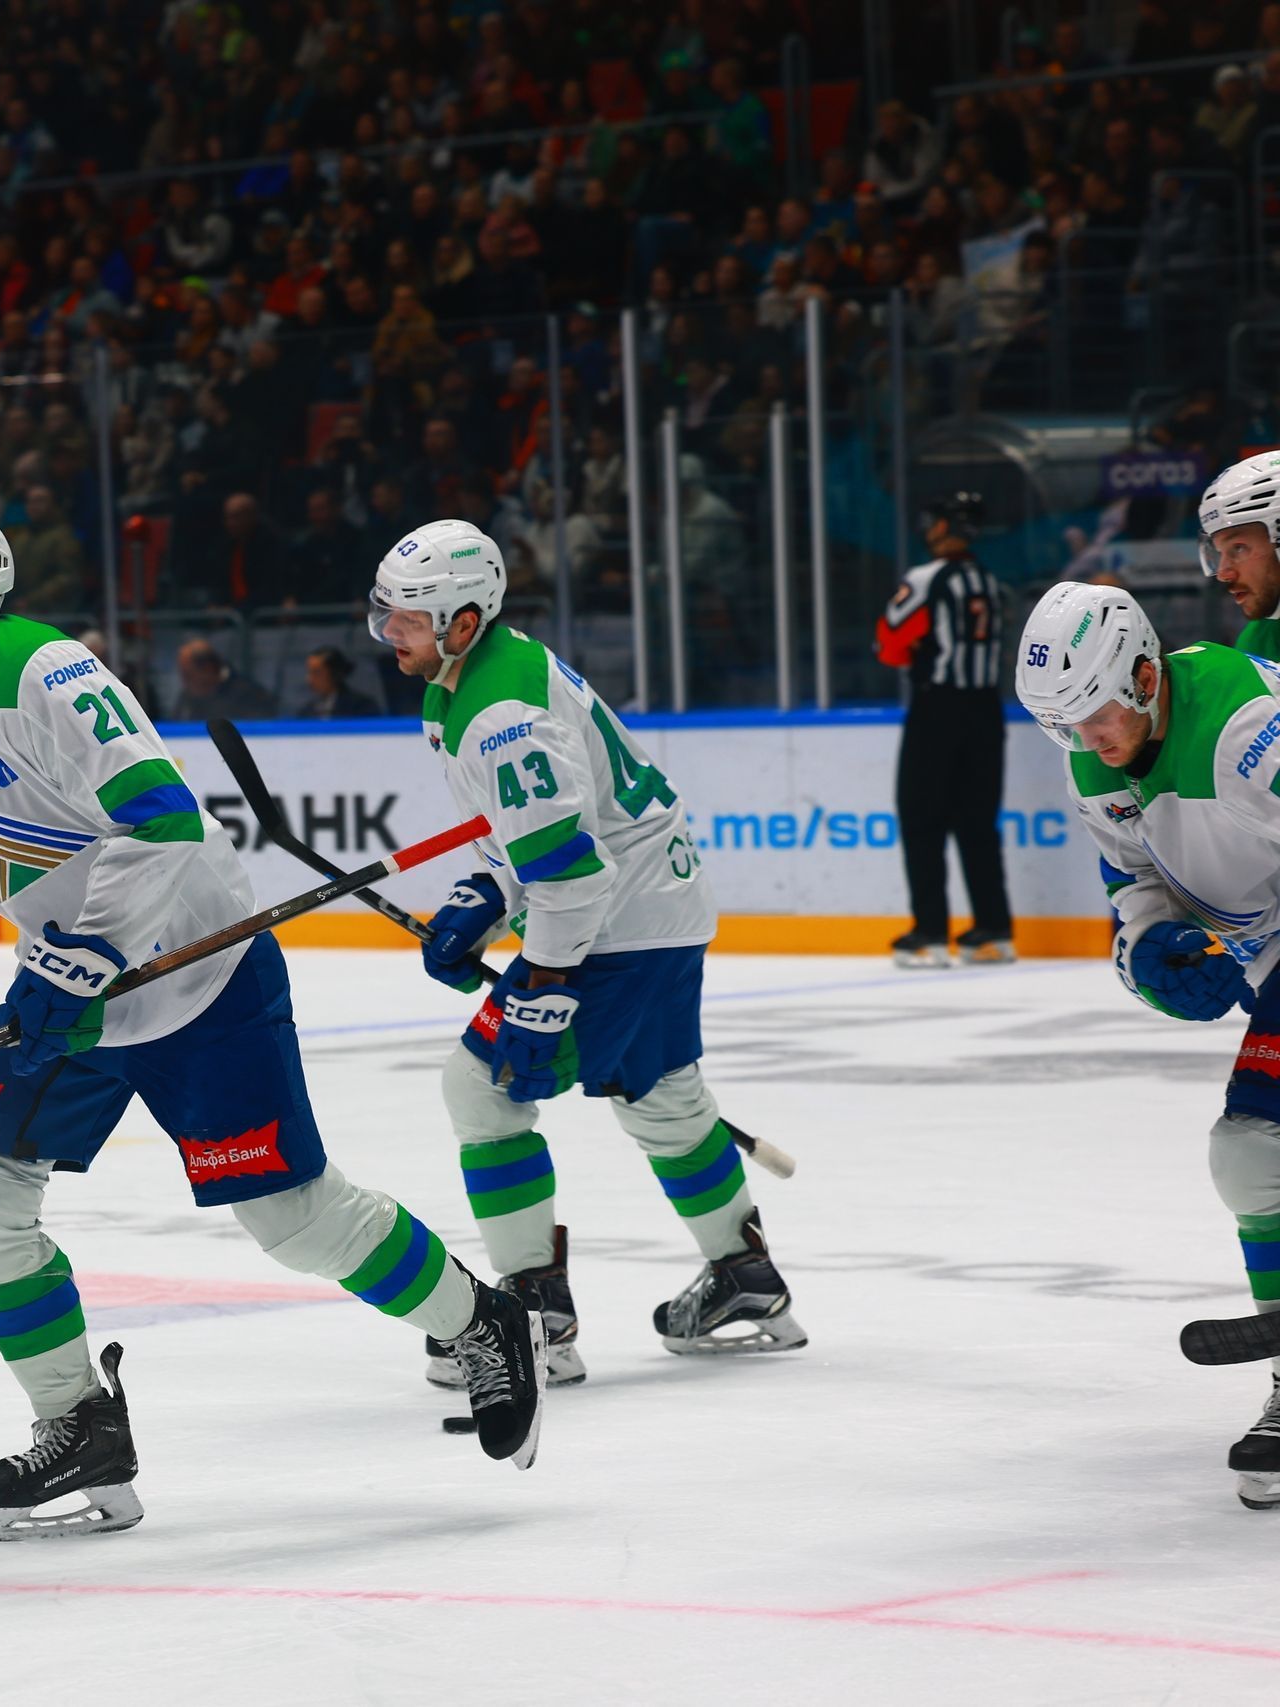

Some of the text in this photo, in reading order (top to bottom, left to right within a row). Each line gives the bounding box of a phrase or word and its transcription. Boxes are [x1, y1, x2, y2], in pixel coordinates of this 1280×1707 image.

[450, 547, 481, 559] FONBET
[1070, 611, 1094, 649] FONBET
[1027, 643, 1050, 667] 56
[43, 658, 98, 691] FONBET
[72, 685, 139, 745] 21
[480, 722, 533, 756] FONBET
[496, 751, 558, 810] 43
[190, 1145, 270, 1170] Альфа Банк
[45, 1466, 81, 1488] BAUER
